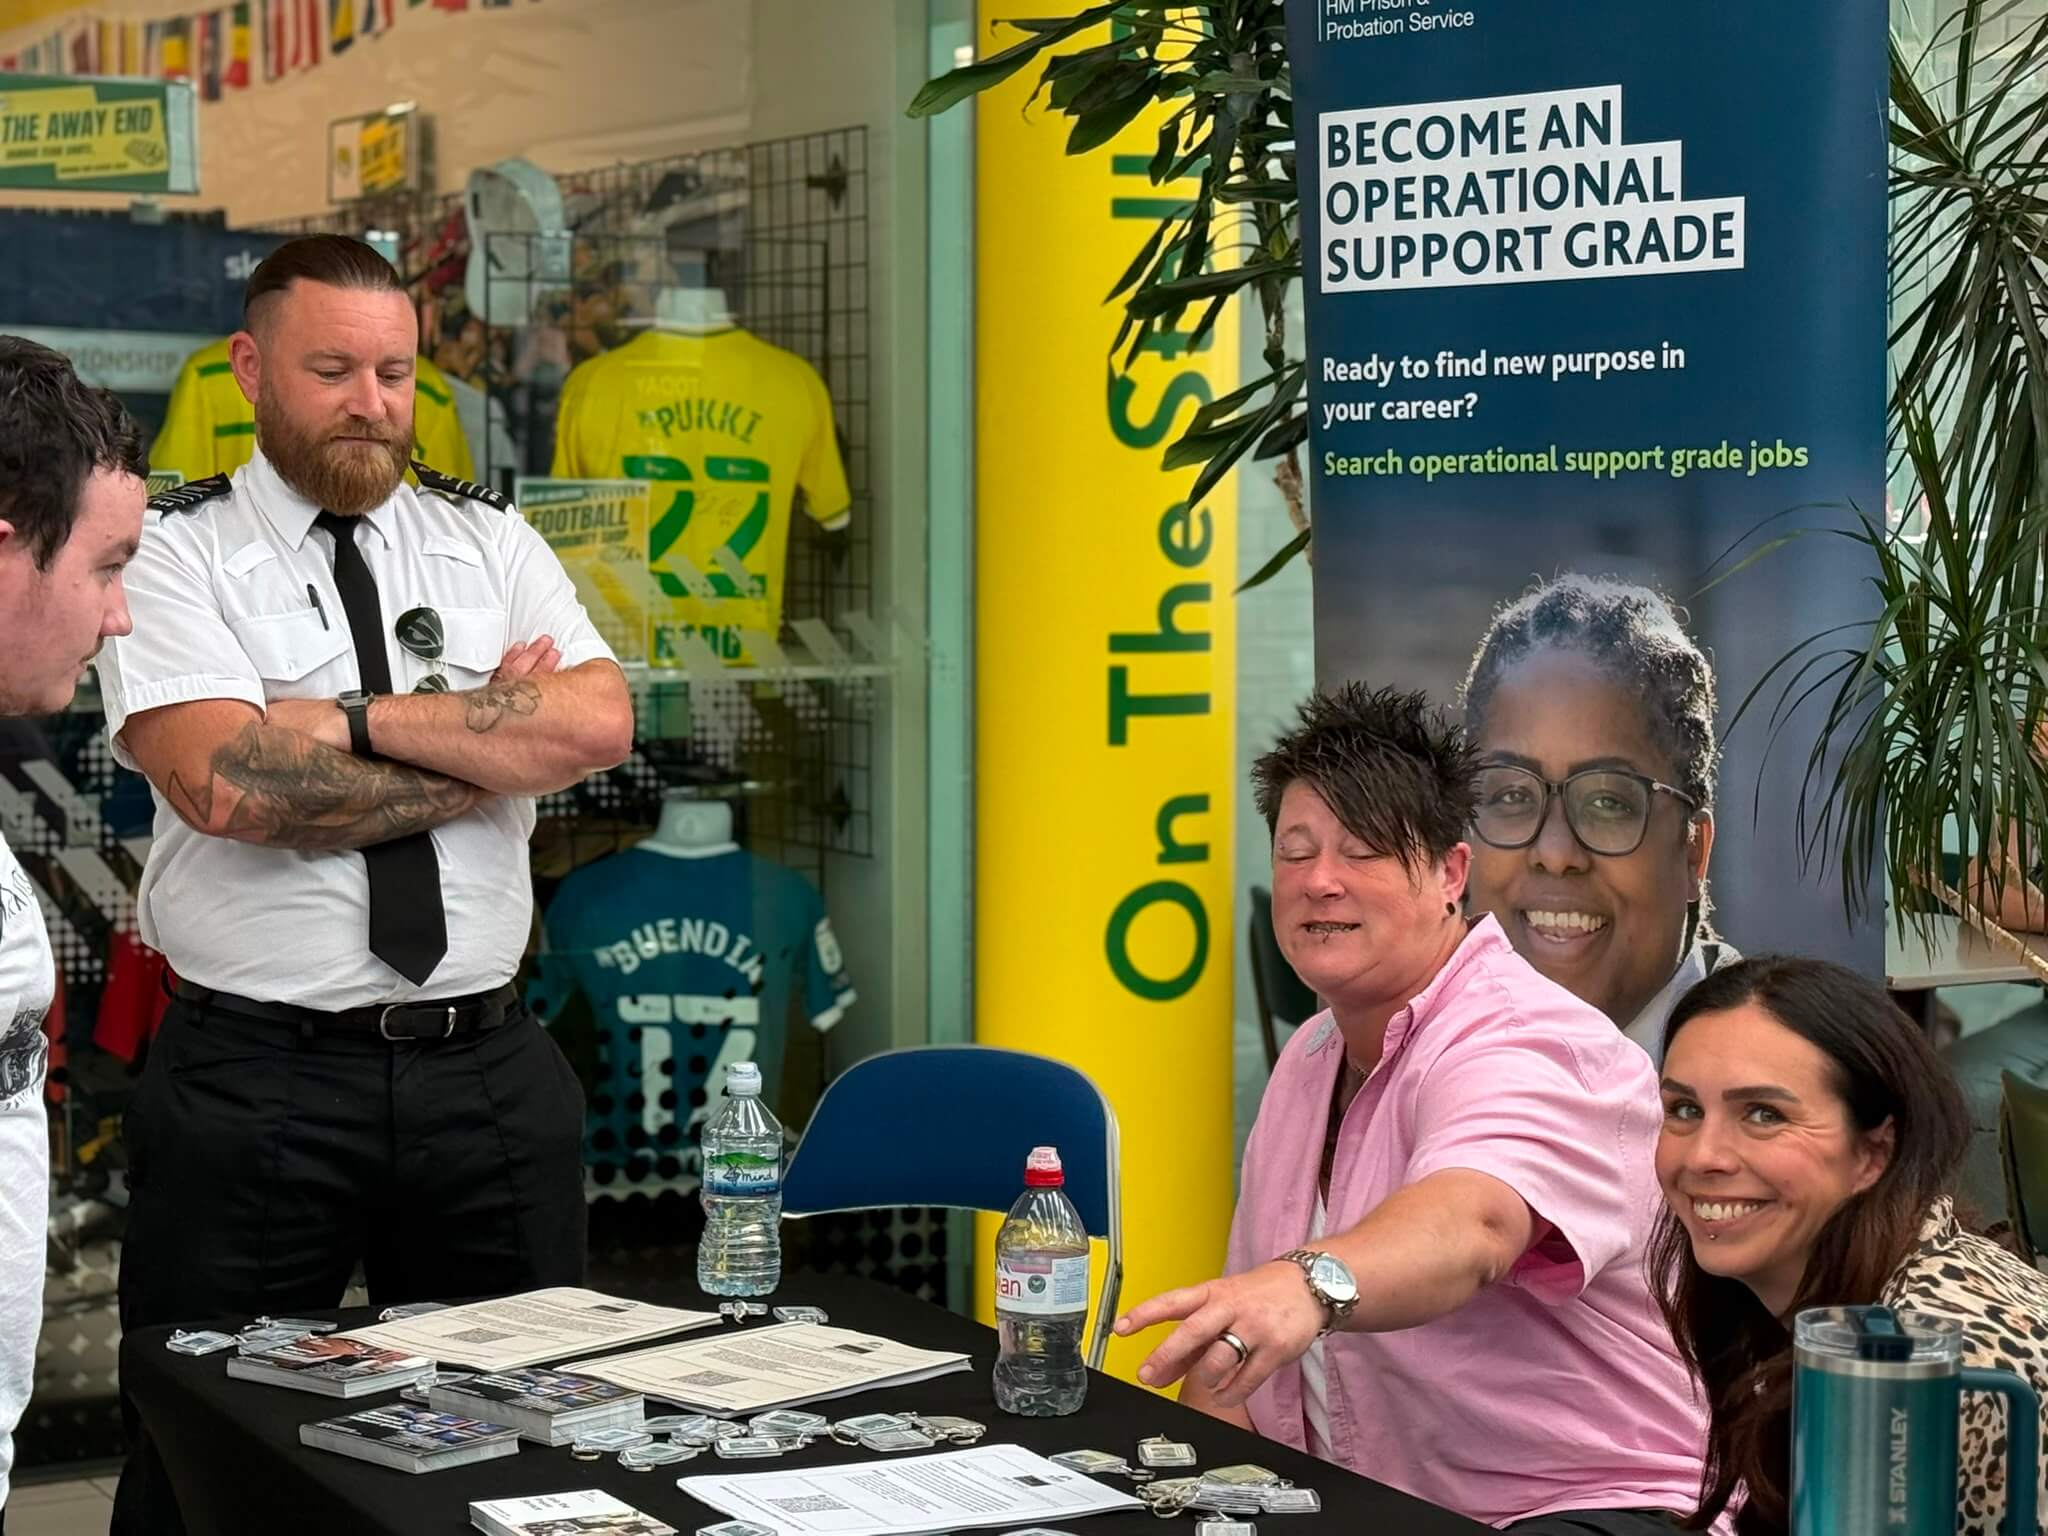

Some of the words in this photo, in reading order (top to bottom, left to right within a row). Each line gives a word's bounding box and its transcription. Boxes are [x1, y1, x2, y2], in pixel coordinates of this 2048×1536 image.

[1326, 0, 1354, 16] HM
[1326, 16, 1404, 41] Probation
[1408, 9, 1475, 32] Service
[3, 112, 41, 142] THE
[45, 108, 108, 139] AWAY
[113, 104, 154, 134] END
[1327, 107, 1527, 168] BECOME
[1539, 99, 1613, 151] AN
[1326, 155, 1676, 225] OPERATIONAL
[224, 250, 264, 279] sk
[1327, 225, 1553, 284] SUPPORT
[1564, 211, 1737, 269] GRADE
[1322, 354, 1396, 388] Ready
[1400, 356, 1430, 380] to
[1435, 349, 1488, 379] find
[1494, 353, 1547, 376] new
[1552, 347, 1656, 381] purpose
[1661, 341, 1686, 370] in
[656, 398, 763, 444] PUKKI
[1322, 400, 1376, 430] your
[1381, 393, 1479, 422] career?
[1324, 448, 1403, 478] Search
[1408, 444, 1559, 482] operational
[1564, 442, 1665, 479] support
[1670, 442, 1744, 479] grade
[1747, 439, 1810, 477] jobs
[531, 500, 629, 533] FOOTBALL
[1107, 500, 1213, 747] The
[1105, 793, 1210, 1002] On
[1890, 1407, 1908, 1500] STANLEY
